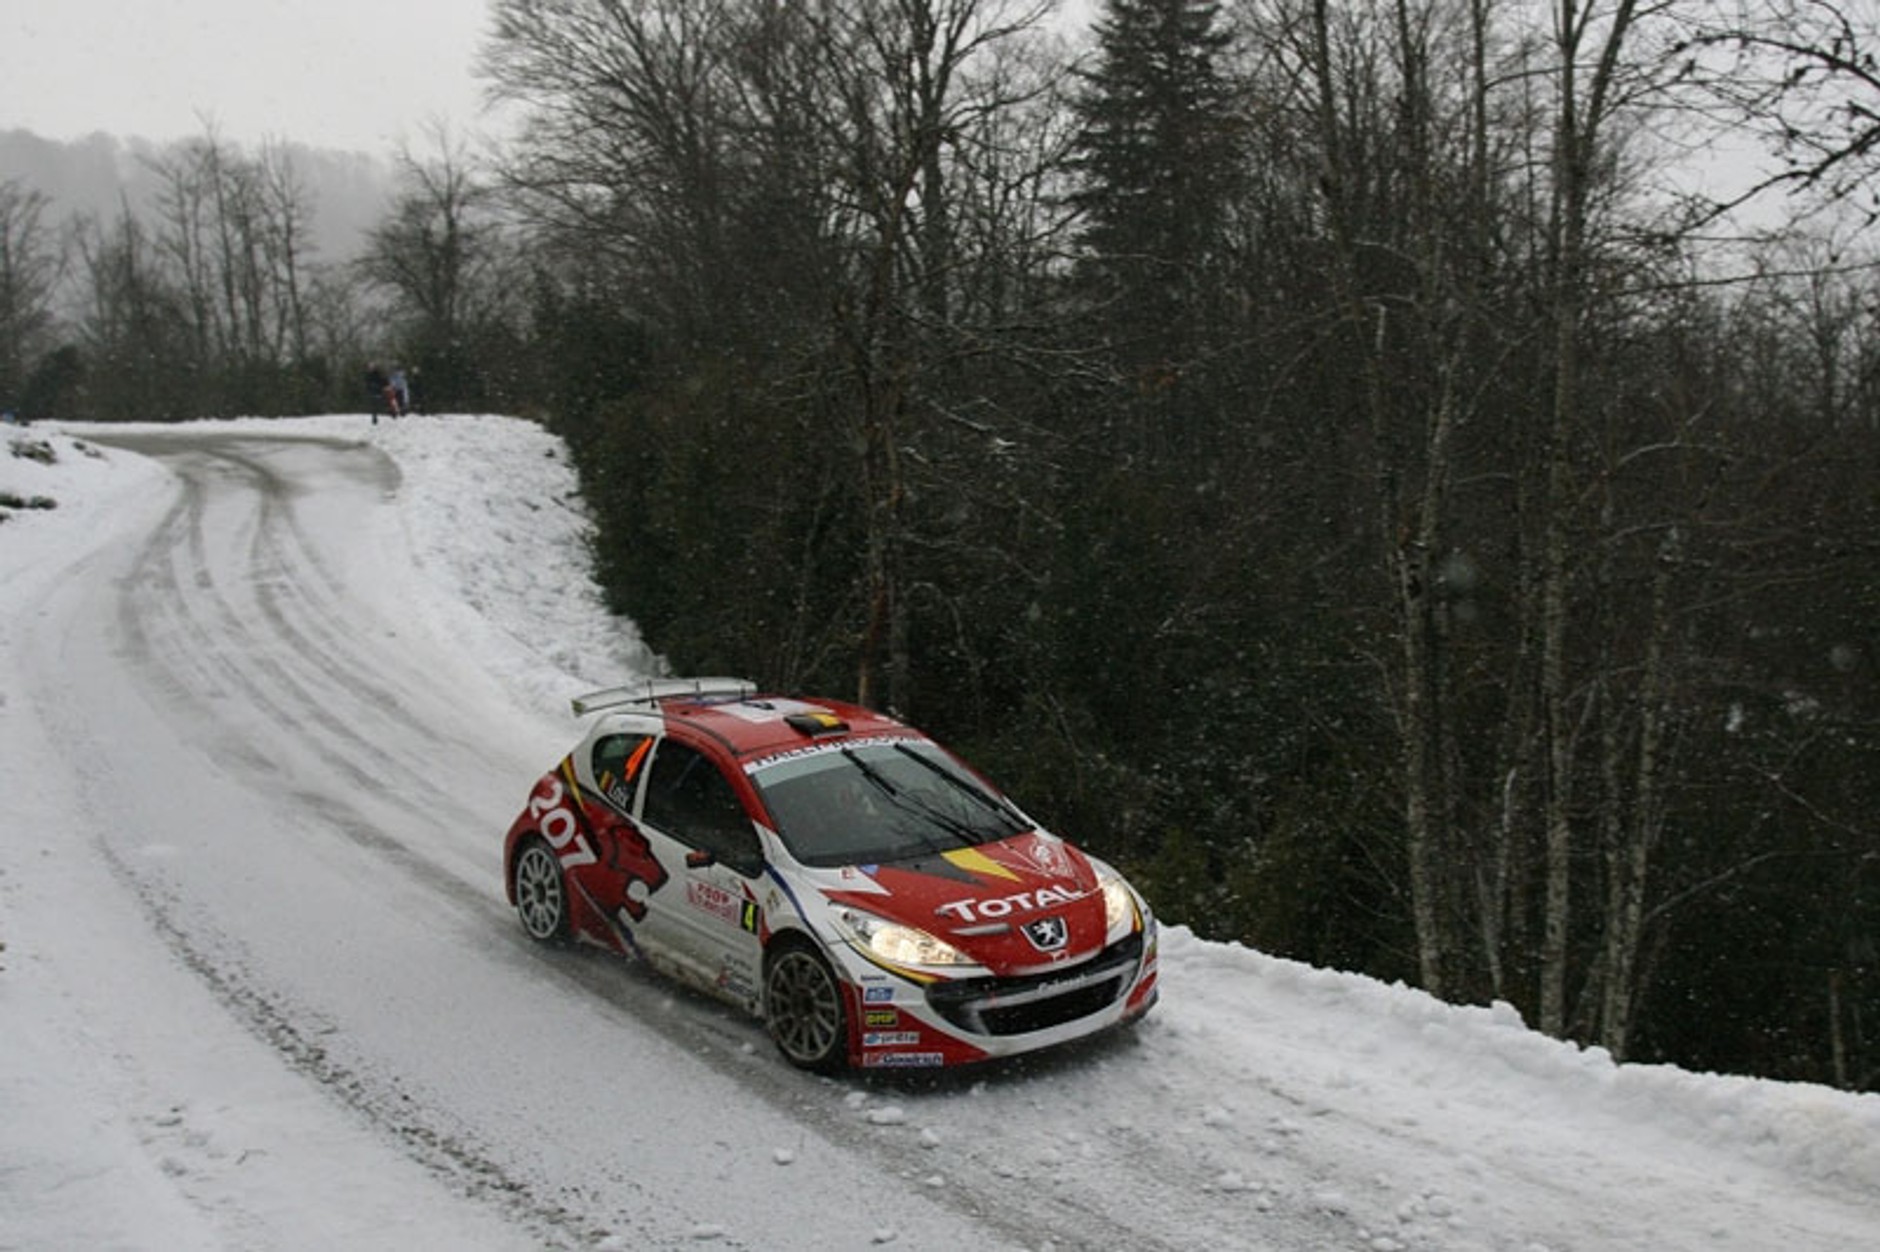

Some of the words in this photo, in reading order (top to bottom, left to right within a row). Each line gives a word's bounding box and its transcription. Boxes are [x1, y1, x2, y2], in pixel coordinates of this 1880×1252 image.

[530, 781, 597, 868] 207
[745, 903, 755, 933] 4
[943, 884, 1084, 922] TOTAL
